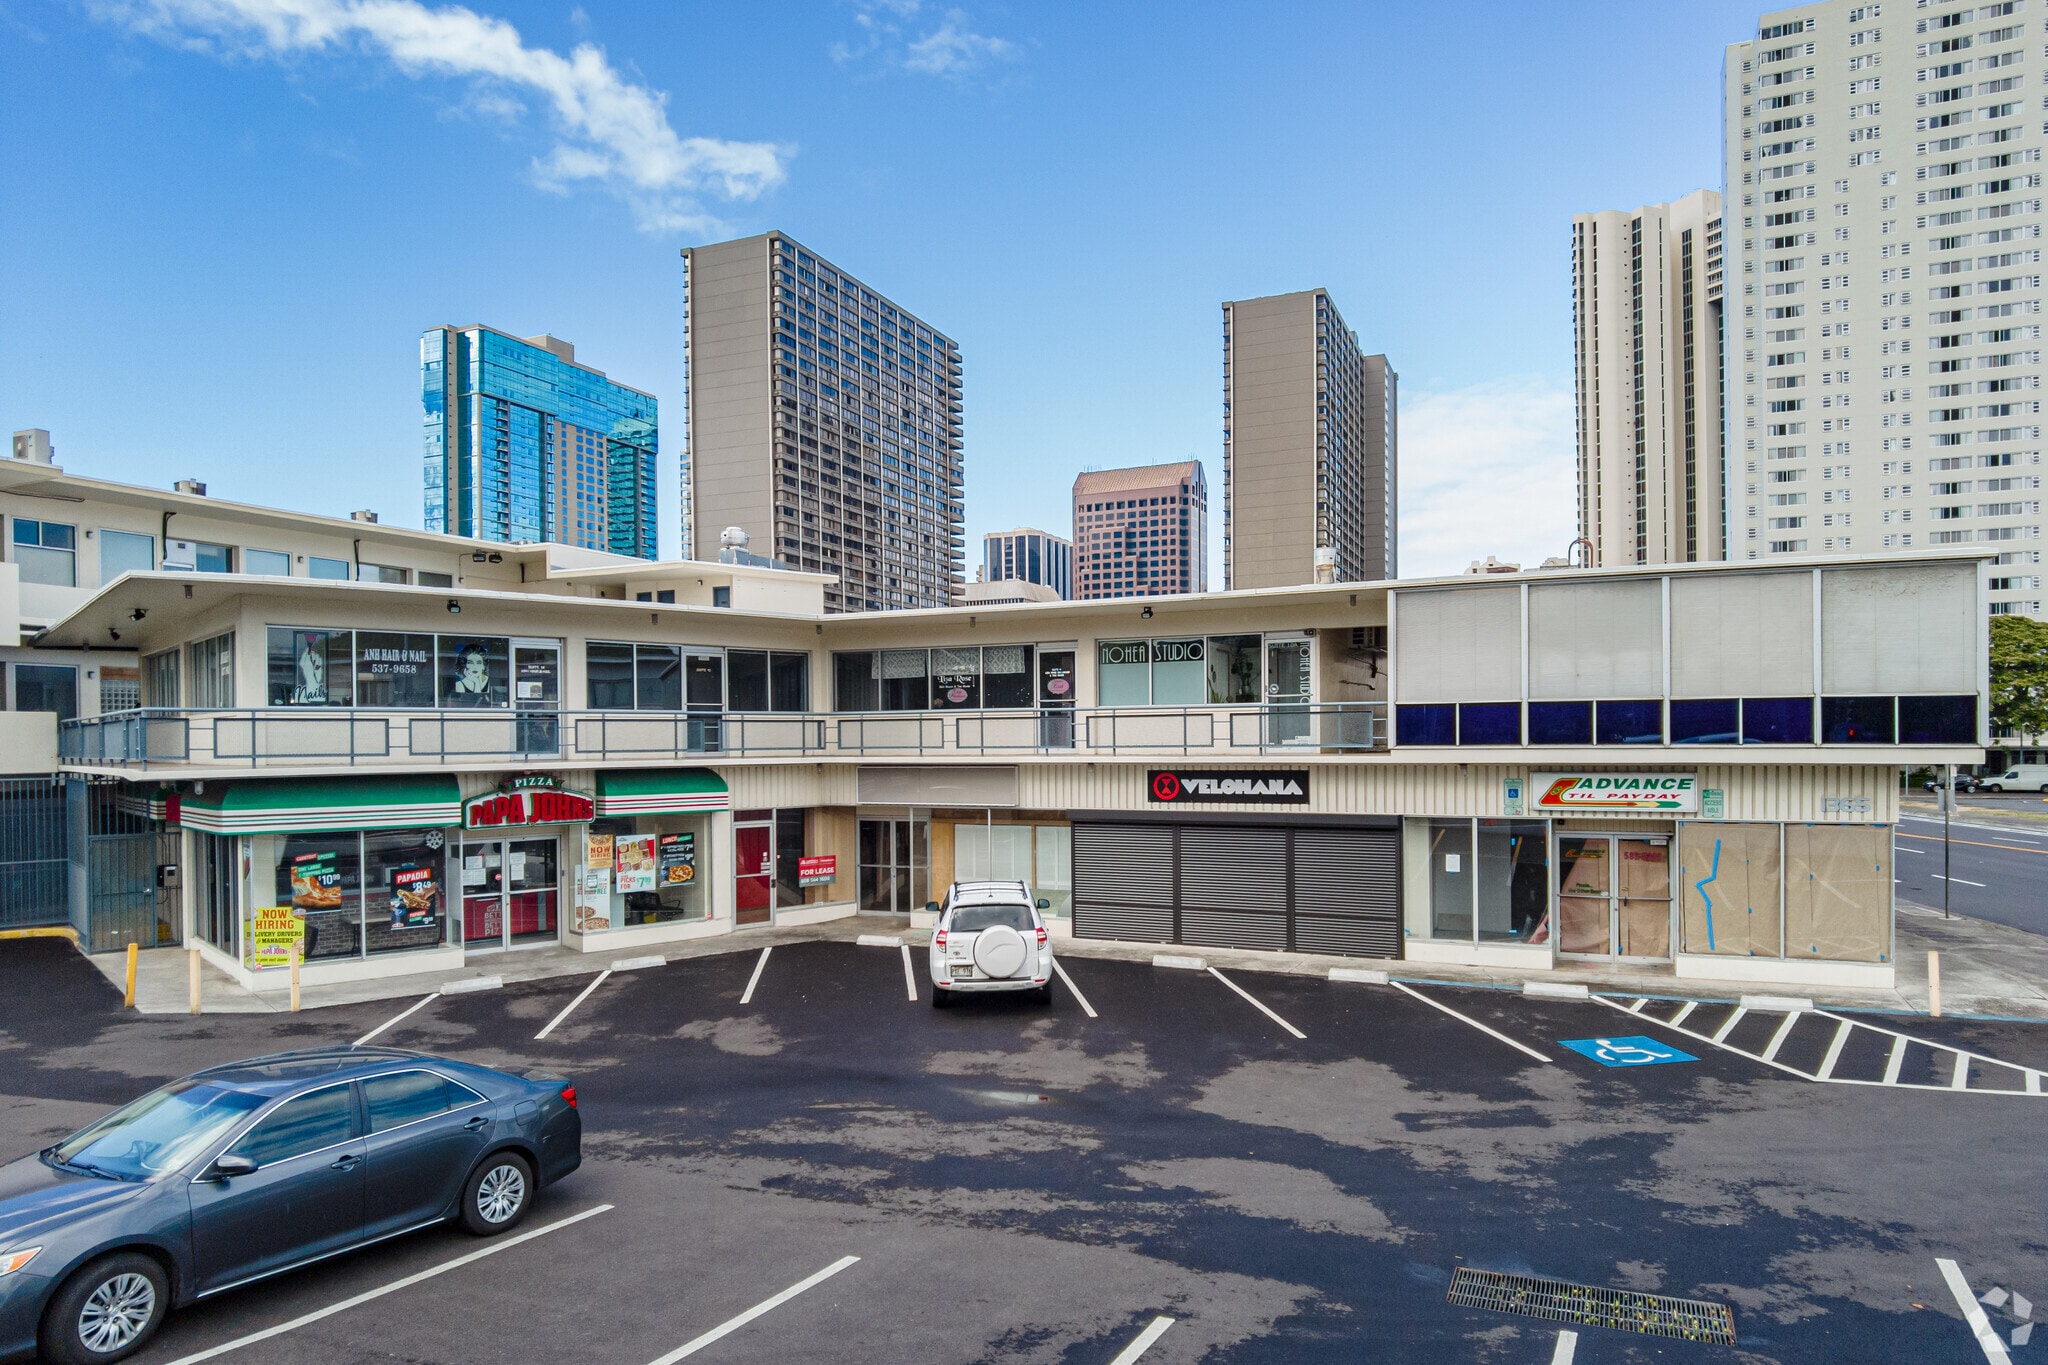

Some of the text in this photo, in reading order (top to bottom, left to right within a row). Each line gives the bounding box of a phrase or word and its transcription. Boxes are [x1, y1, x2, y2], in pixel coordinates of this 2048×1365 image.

[364, 648, 380, 661] ANH
[382, 649, 400, 662] HAIR
[409, 650, 427, 663] NAIL
[1102, 643, 1203, 664] NOHEA STUDIO
[372, 664, 416, 674] 537-9658
[295, 685, 328, 702] Nails
[515, 778, 554, 788] PIZZA
[1181, 778, 1304, 795] VELOHANA
[1579, 778, 1694, 790] ADVANCE
[470, 794, 526, 826] PAPA
[1821, 795, 1871, 812] 1365
[397, 870, 428, 884] PAPADIA
[262, 910, 288, 919] NOW
[256, 920, 294, 930] HIRING
